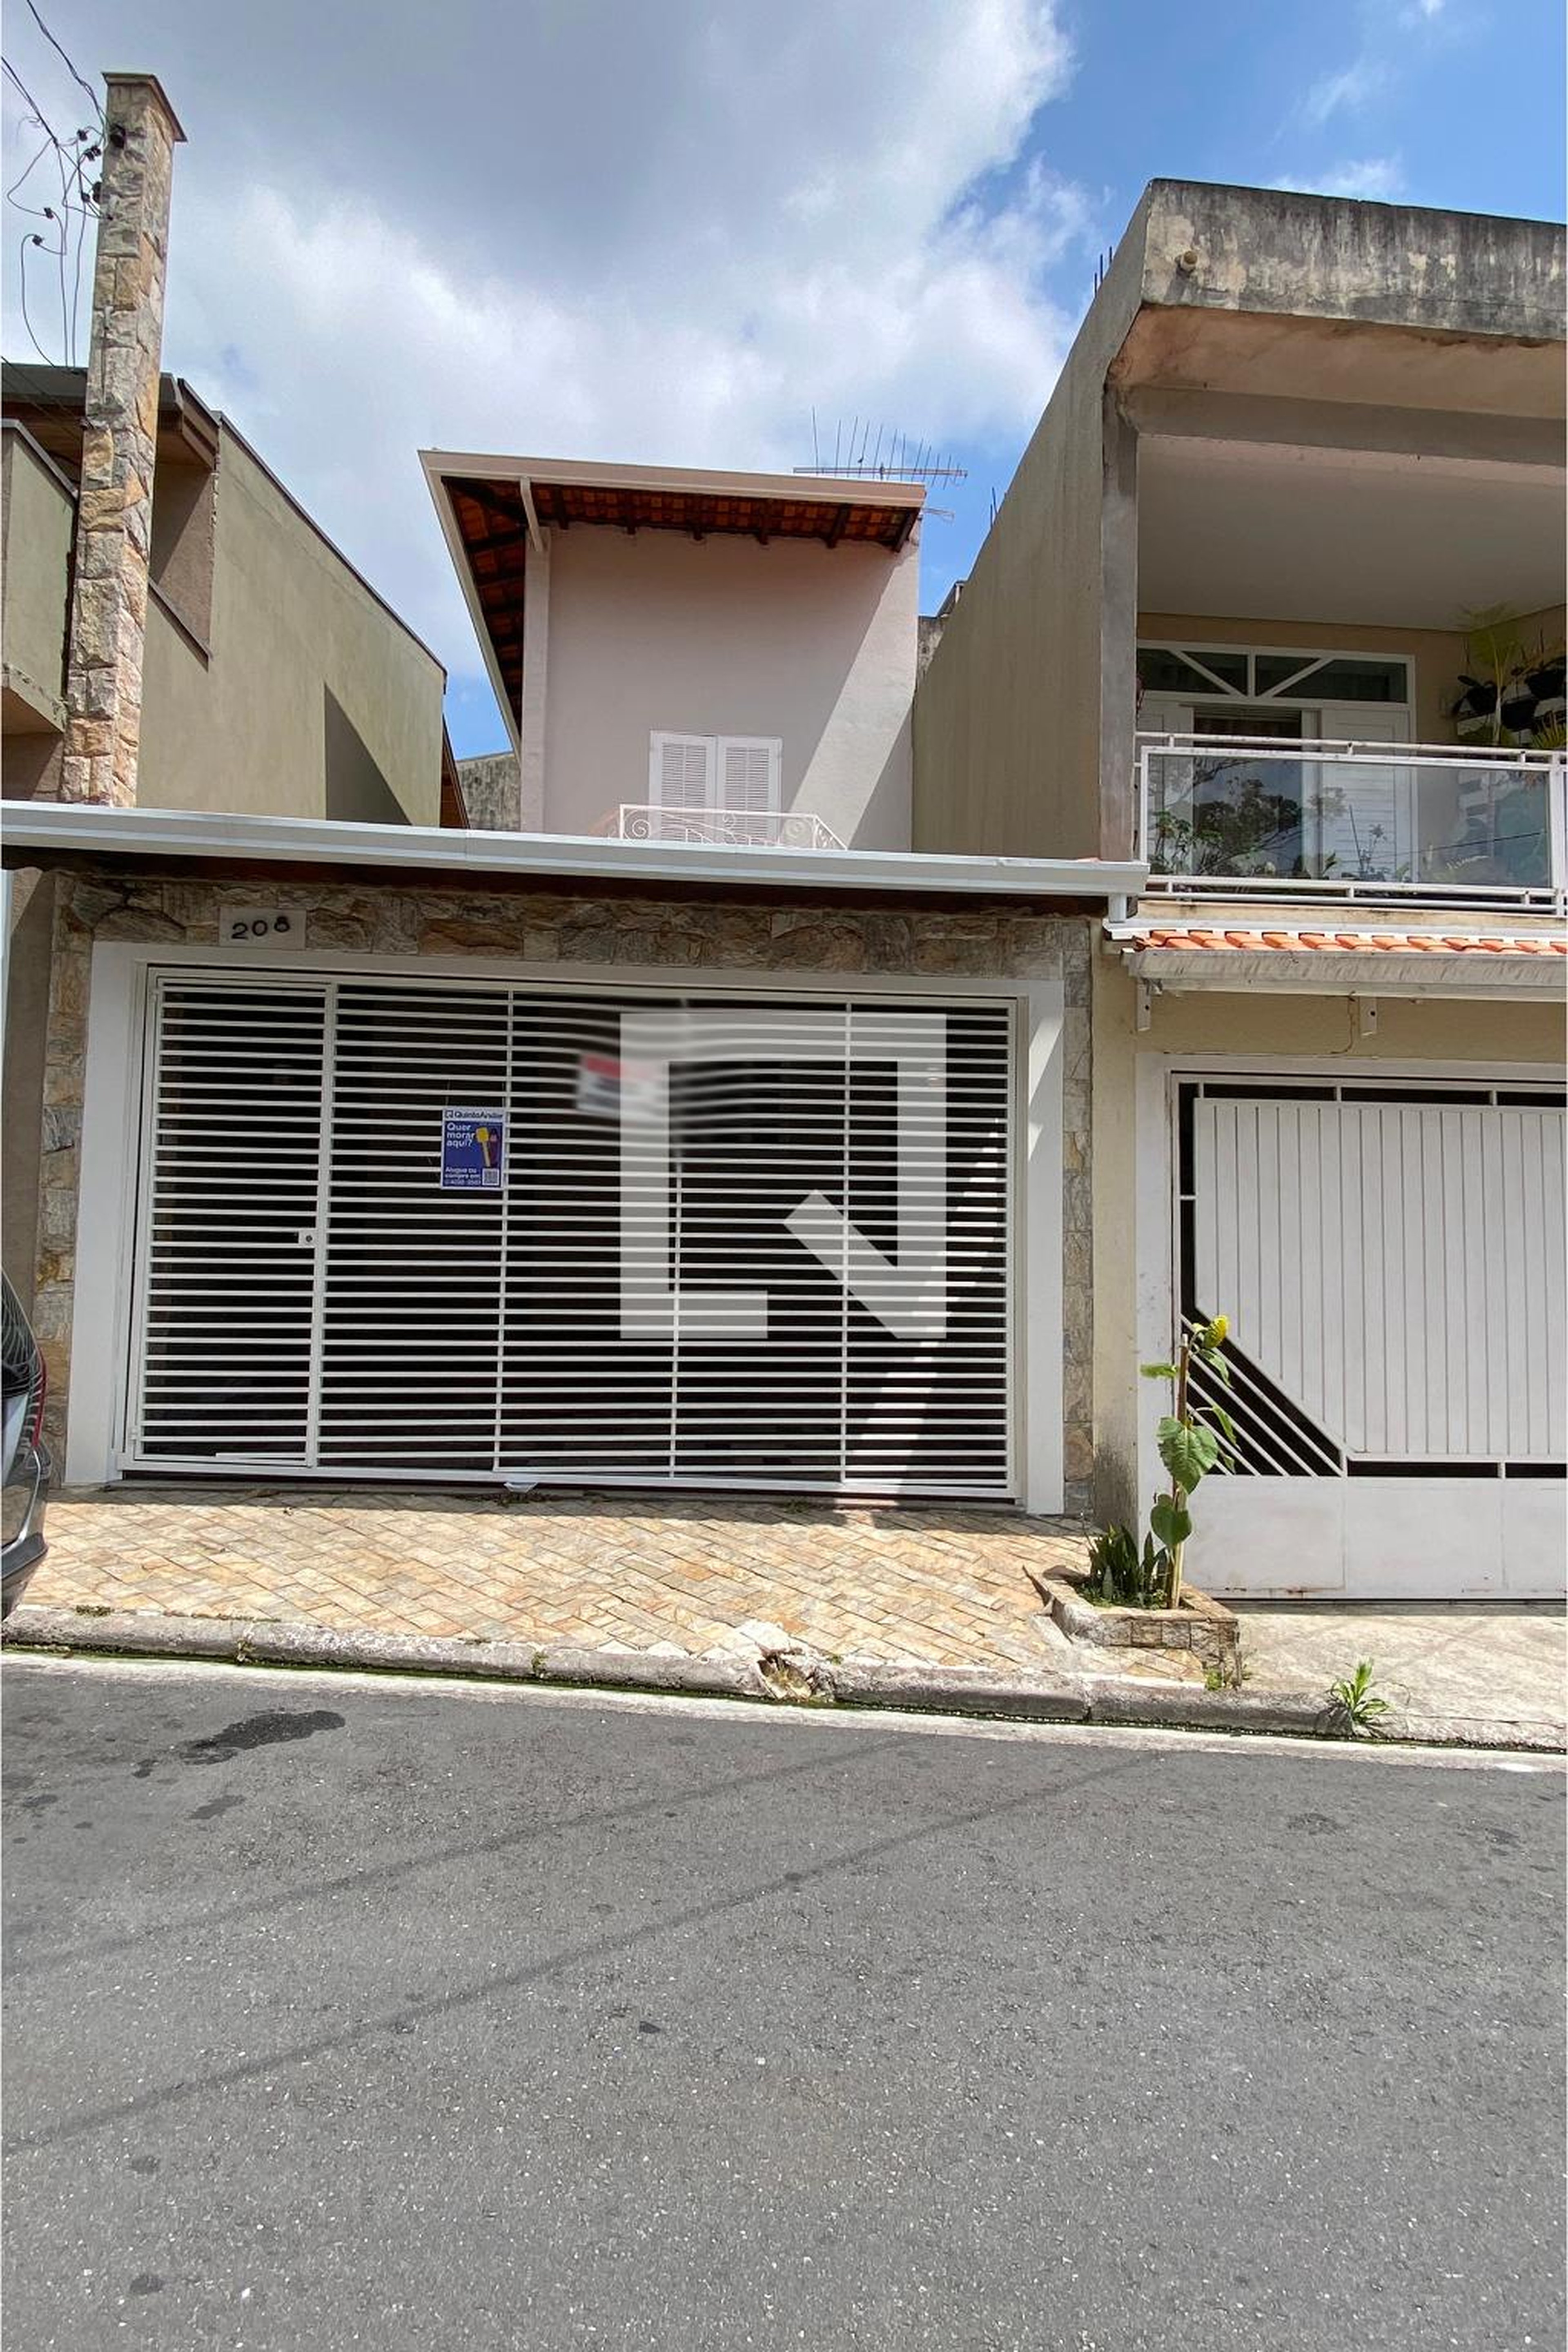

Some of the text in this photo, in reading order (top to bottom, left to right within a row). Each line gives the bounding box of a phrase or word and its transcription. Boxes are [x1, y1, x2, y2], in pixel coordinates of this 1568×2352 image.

[231, 916, 290, 940] 208
[447, 1122, 471, 1131] Quer
[447, 1139, 472, 1148] aqui?
